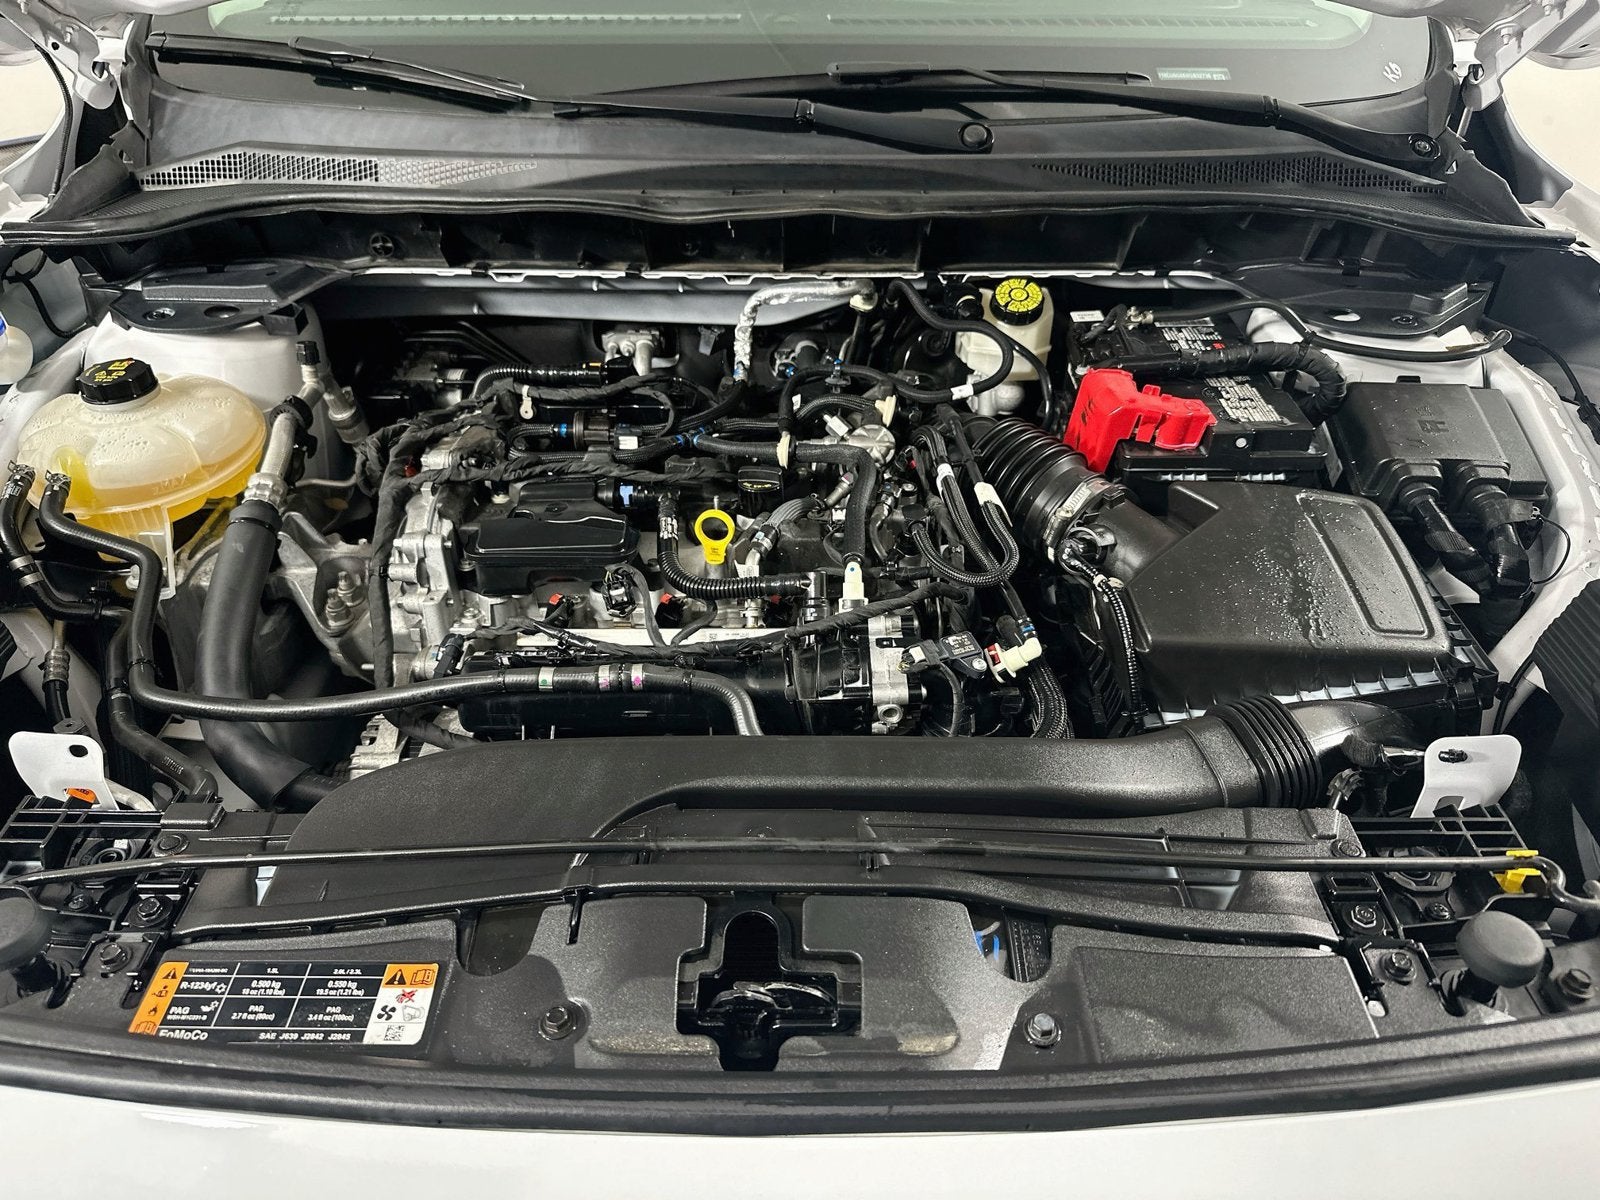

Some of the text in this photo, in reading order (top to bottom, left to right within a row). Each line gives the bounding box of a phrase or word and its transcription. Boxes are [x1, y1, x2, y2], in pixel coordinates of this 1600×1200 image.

[180, 981, 217, 991] R-1234yf
[251, 980, 281, 989] 0.500 kg
[327, 980, 358, 989] 0.550 kg
[169, 1006, 190, 1014] PAG
[259, 1032, 277, 1040] SAE
